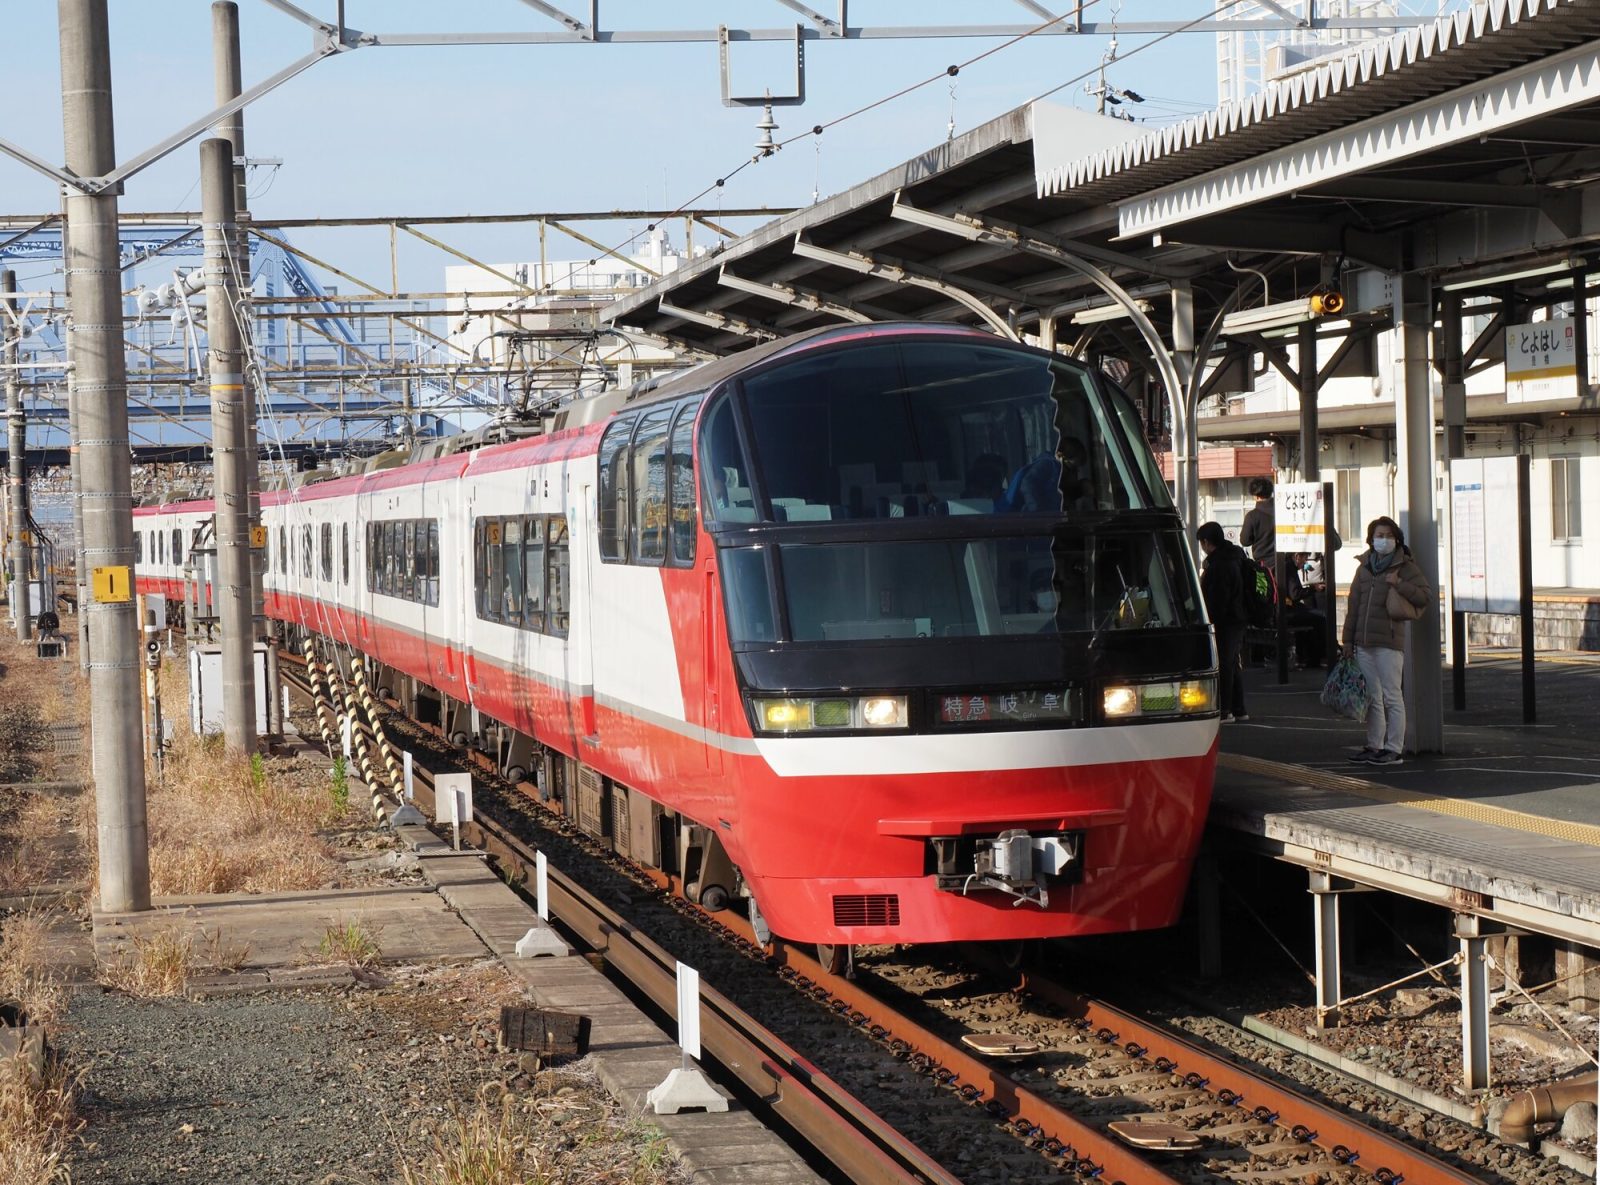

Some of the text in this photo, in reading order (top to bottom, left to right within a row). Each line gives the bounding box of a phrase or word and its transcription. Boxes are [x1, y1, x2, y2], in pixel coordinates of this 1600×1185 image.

[1521, 329, 1560, 353] とよはし
[1285, 491, 1312, 510] とよはし
[257, 530, 262, 542] 2
[109, 573, 114, 594] 1
[944, 692, 1061, 716] 特急 岐阜
